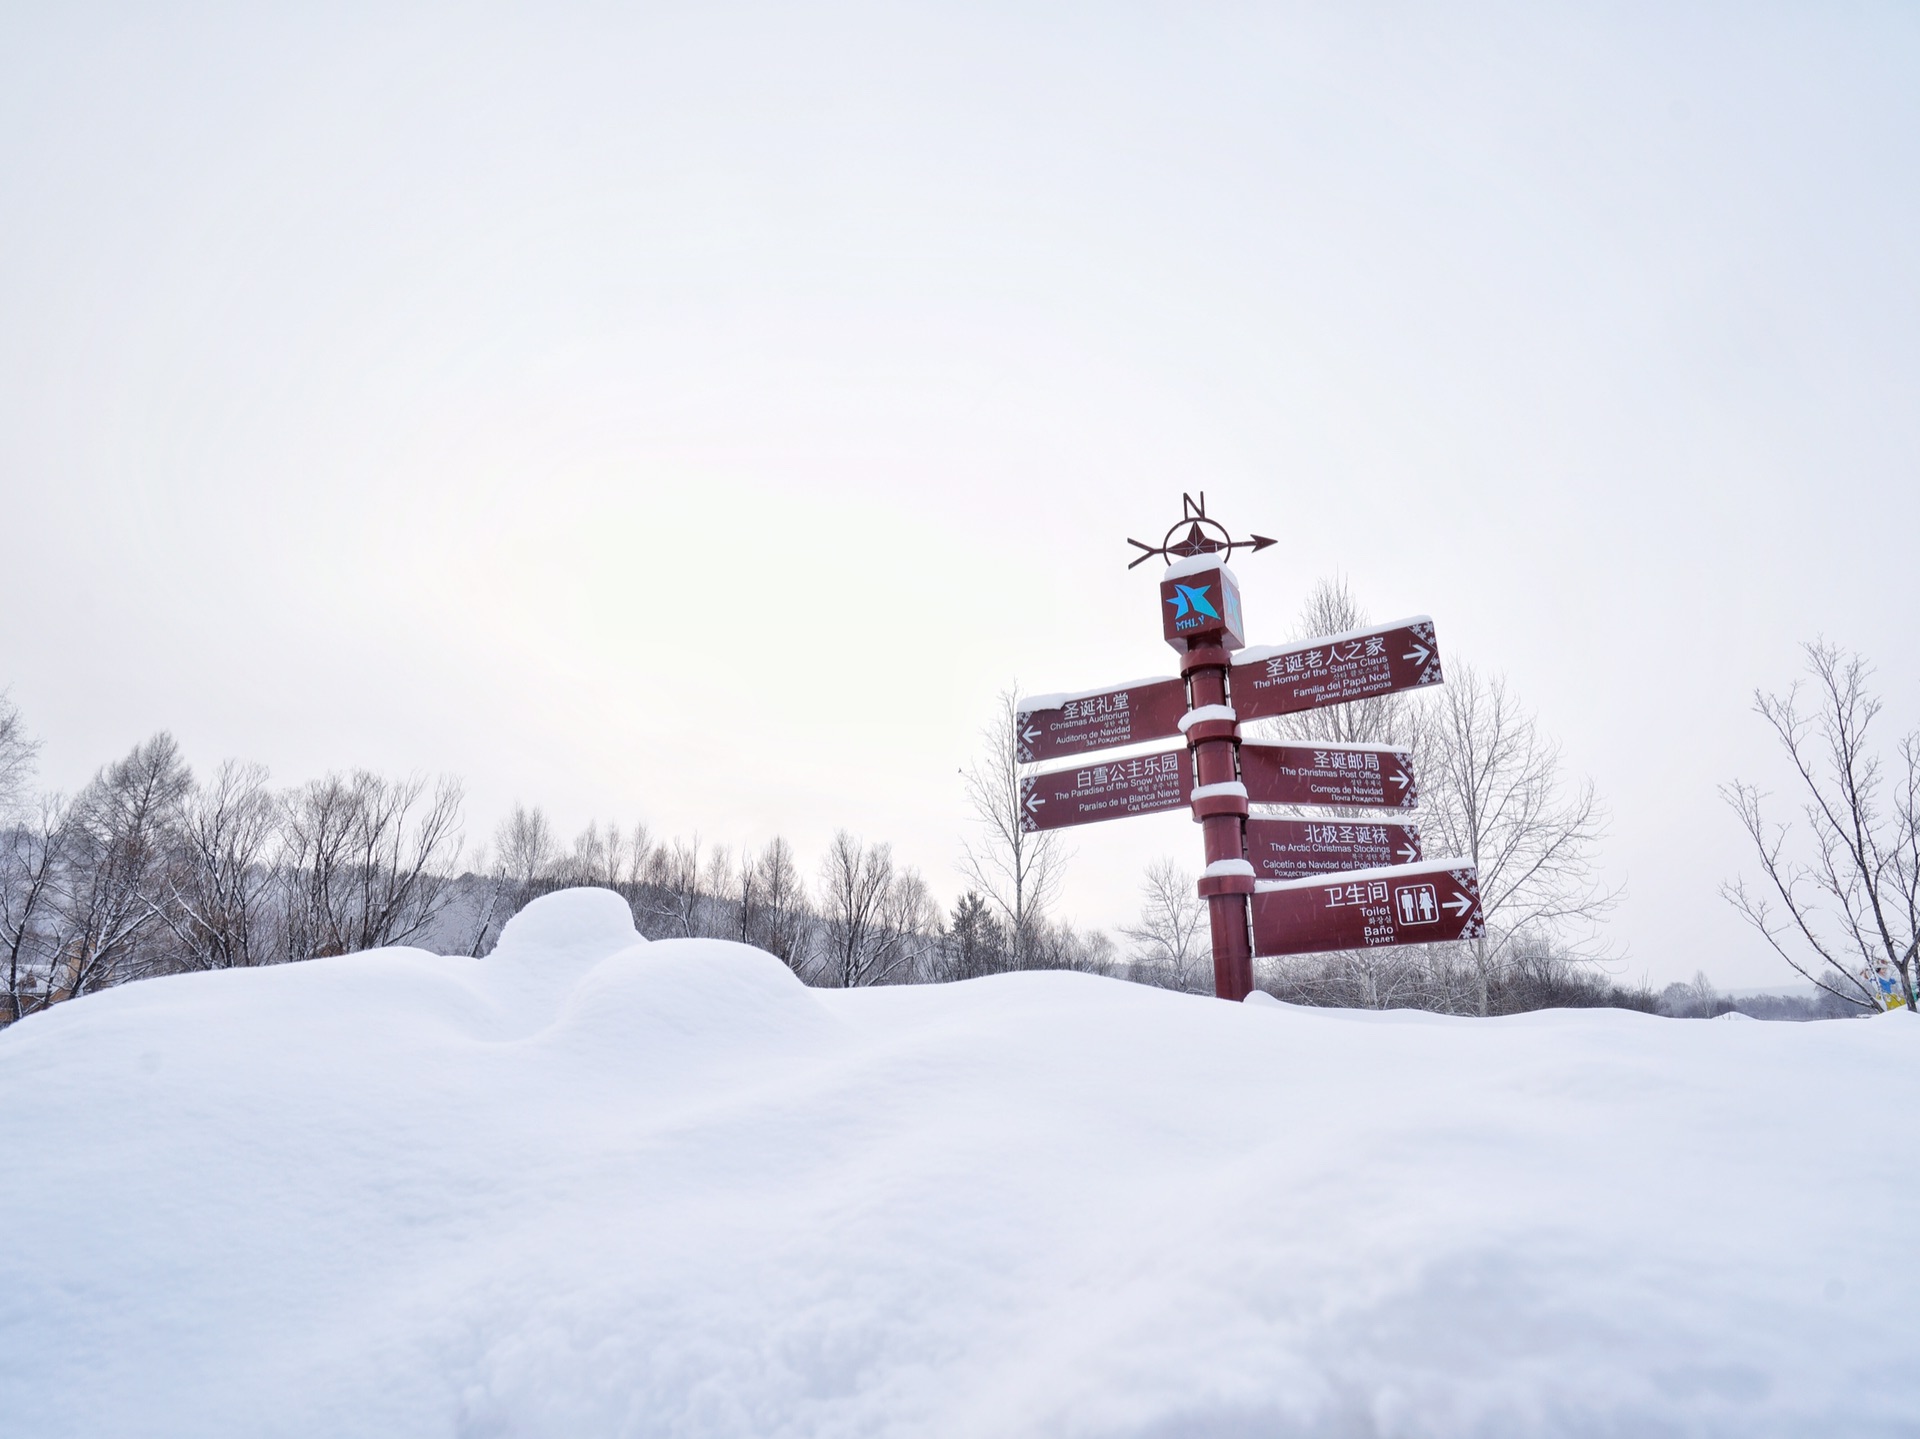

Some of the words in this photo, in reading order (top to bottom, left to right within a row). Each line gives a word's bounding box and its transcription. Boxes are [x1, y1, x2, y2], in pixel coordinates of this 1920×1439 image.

[1183, 491, 1205, 521] N
[1175, 614, 1204, 632] MHLY
[1266, 637, 1386, 678] 圣诞老人之家
[1253, 680, 1270, 689] The
[1272, 675, 1299, 686] Home
[1302, 671, 1311, 680] of
[1313, 667, 1327, 677] the
[1330, 662, 1357, 673] Santa
[1359, 656, 1388, 667] Claus
[1293, 686, 1325, 698] Familia
[1327, 681, 1340, 690] del
[1341, 675, 1367, 687] Papá
[1369, 671, 1391, 682] Noel
[1315, 692, 1340, 702] Домик
[1340, 687, 1361, 697] Деда
[1363, 681, 1392, 691] мороза
[1063, 692, 1129, 720] 圣诞礼堂
[1050, 719, 1087, 731] Christmas
[1089, 711, 1130, 724] Auditorium
[1056, 732, 1088, 744] Auditorio
[1089, 730, 1098, 738] de
[1100, 725, 1130, 737] Navidad
[1086, 738, 1097, 746] Зал
[1077, 753, 1179, 788] 白雪公主乐园
[1314, 751, 1380, 771] 圣诞邮局
[1280, 767, 1296, 776] The
[1298, 768, 1338, 778] Christmas
[1340, 770, 1357, 779] Post
[1359, 771, 1381, 780] Office
[1055, 791, 1070, 800] The
[1071, 785, 1104, 798] Paradise
[1106, 783, 1114, 791] of
[1116, 780, 1128, 789] the
[1130, 778, 1153, 788] Snow
[1155, 772, 1179, 783] White
[1311, 784, 1340, 793] Correos
[1342, 785, 1351, 794] de
[1353, 786, 1383, 795] Navidad
[1109, 798, 1118, 807] de
[1120, 797, 1127, 805] la
[1129, 793, 1155, 803] Blanca
[1157, 789, 1180, 799] Nieve
[1304, 824, 1389, 844] 北极圣诞袜
[1270, 843, 1286, 852] The
[1288, 843, 1310, 852] Arctic
[1312, 843, 1351, 853] Christmas
[1353, 844, 1390, 855] Stockings
[1297, 860, 1307, 869] de
[1308, 861, 1339, 869] Navidad
[1341, 861, 1353, 870] del
[1354, 861, 1370, 870] Polo
[1323, 881, 1389, 908] 卫生间
[1360, 905, 1391, 917] Toilet
[1364, 925, 1394, 937] Baño
[1364, 936, 1395, 946] Туалет
